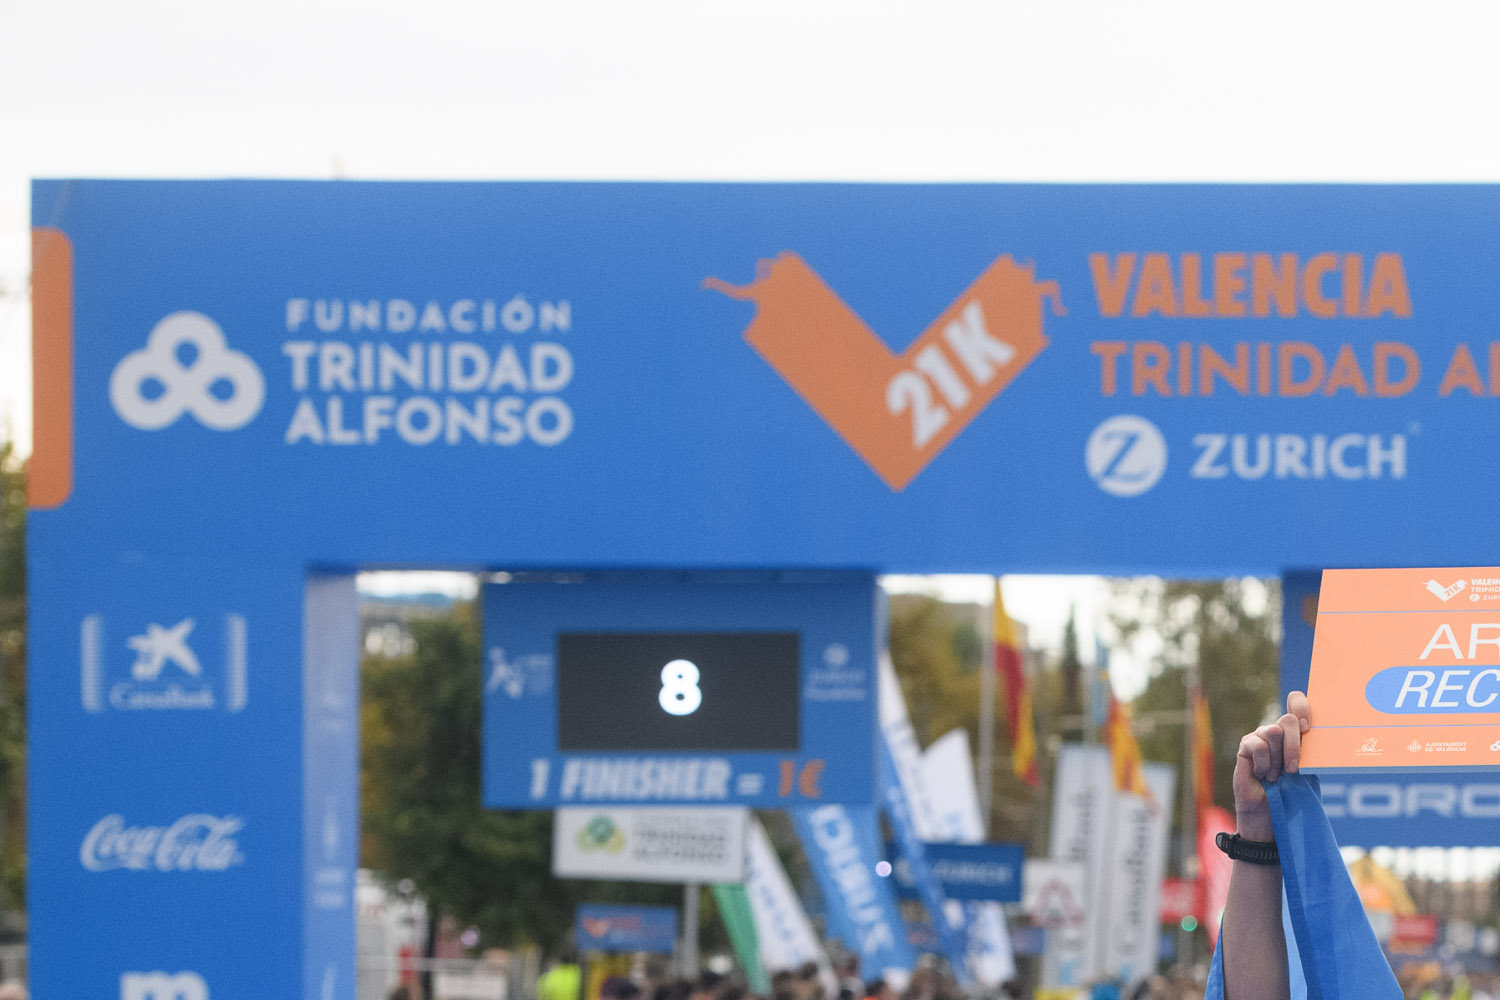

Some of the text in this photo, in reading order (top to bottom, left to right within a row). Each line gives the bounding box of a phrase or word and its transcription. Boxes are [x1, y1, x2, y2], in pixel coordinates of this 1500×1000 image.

[1088, 252, 1413, 318] VALENCIA
[286, 295, 572, 332] FUNDACIÓN
[282, 341, 574, 392] TRINIDAD
[886, 300, 1016, 449] 21K
[1090, 340, 1422, 398] TRINIDAD
[284, 396, 574, 446] ALFONSO
[1190, 433, 1408, 480] ZURICH
[658, 658, 702, 716] 8
[560, 757, 732, 800] FINISHER
